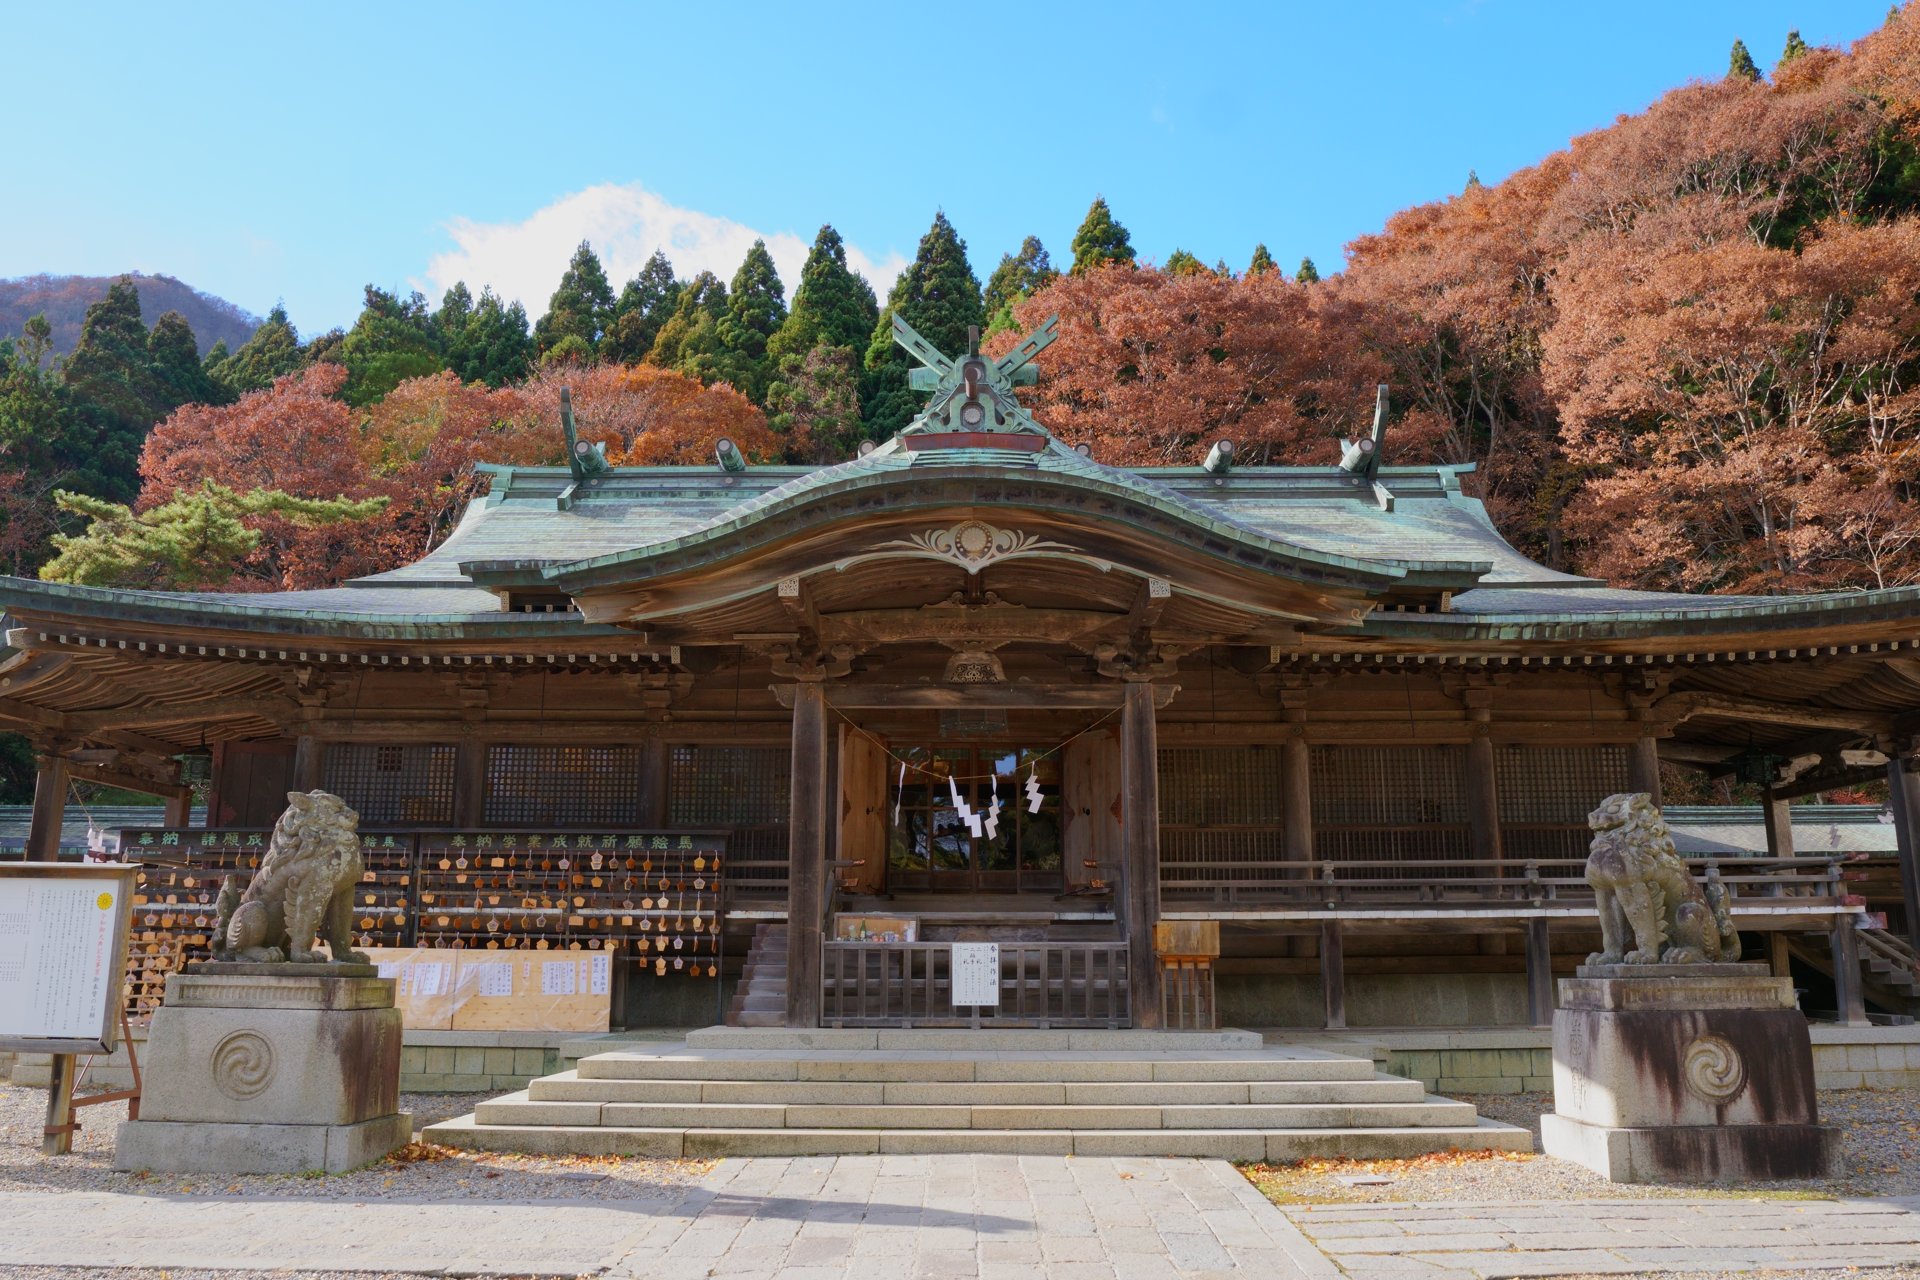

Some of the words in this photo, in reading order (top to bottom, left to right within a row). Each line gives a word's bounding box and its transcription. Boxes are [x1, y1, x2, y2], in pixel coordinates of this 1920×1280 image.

[138, 832, 179, 846] 奉納
[201, 832, 263, 846] 諸願成
[363, 835, 395, 848] 絵馬
[451, 834, 693, 849] 奉納学業成就祈願絵馬
